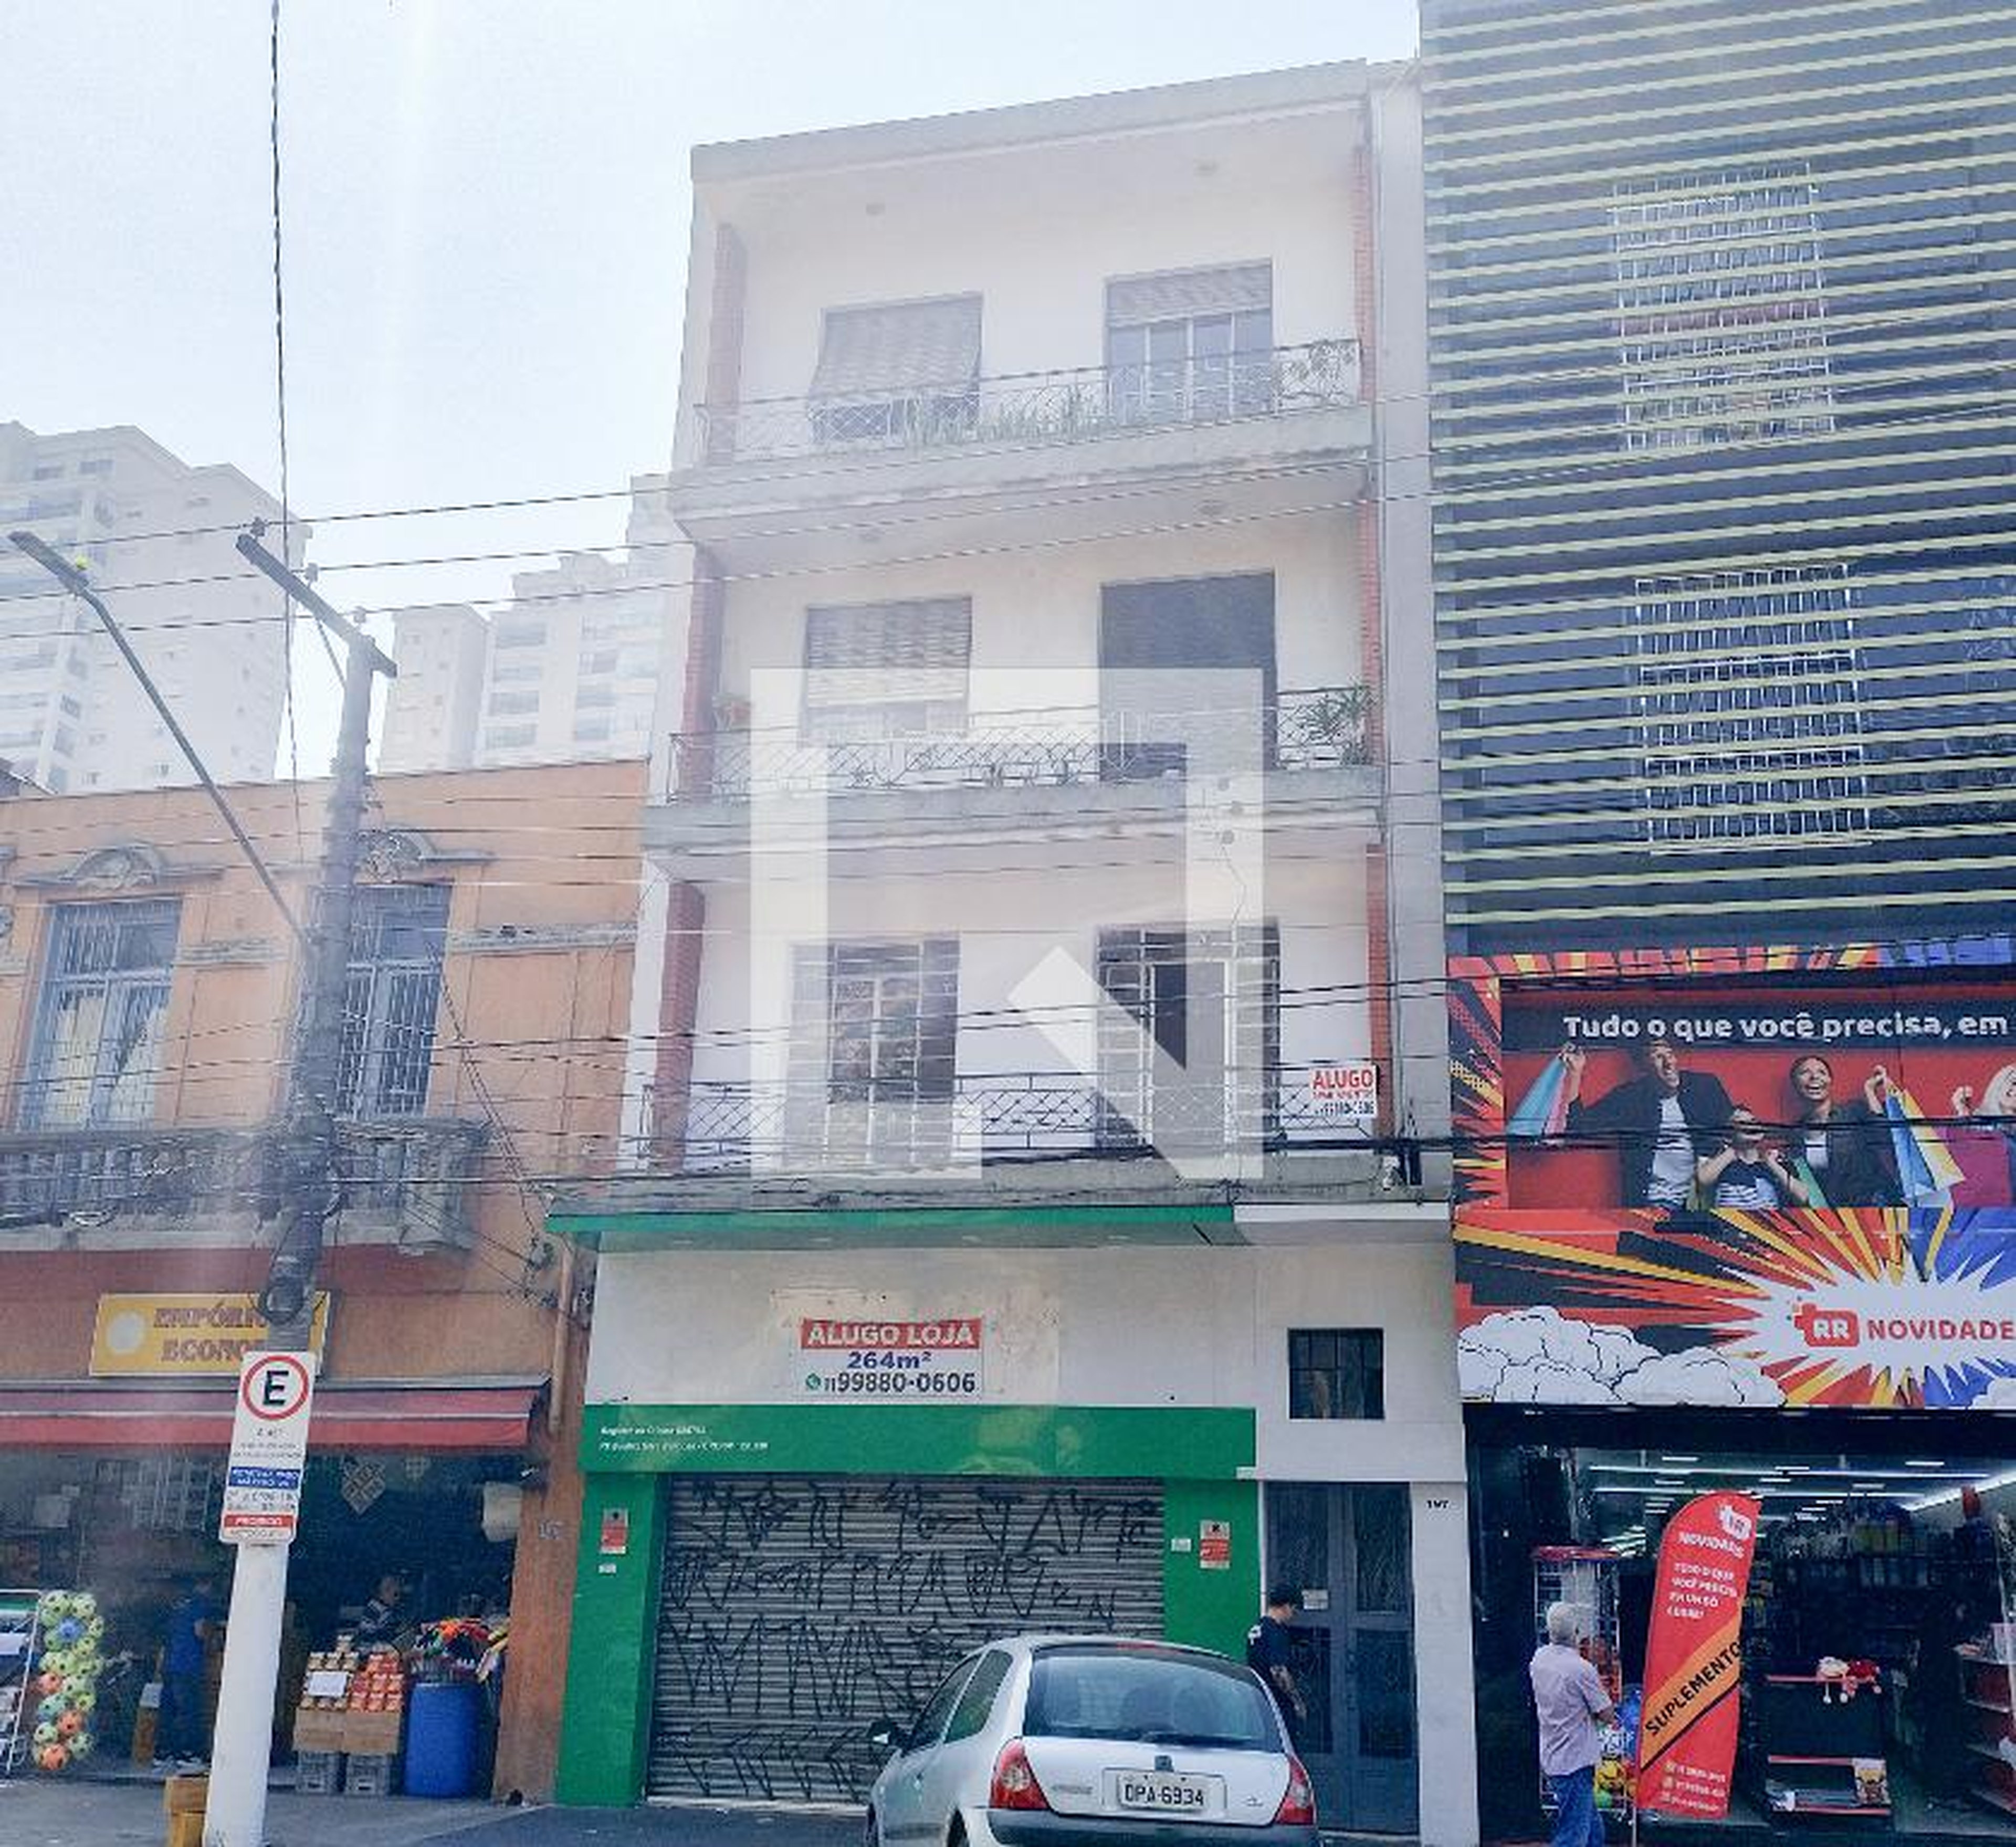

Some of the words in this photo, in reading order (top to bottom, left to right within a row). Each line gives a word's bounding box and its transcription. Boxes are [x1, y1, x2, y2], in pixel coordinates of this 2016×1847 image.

[1563, 1015, 1640, 1037] Tudo
[1647, 1018, 1666, 1037] o
[1674, 1018, 1733, 1042] que
[1738, 1012, 1814, 1037] você
[1823, 1011, 1951, 1042] precisa,
[1958, 1016, 2008, 1036] em
[1313, 1069, 1373, 1090] ALUGO
[808, 1324, 900, 1346] ALUGO
[908, 1324, 975, 1346] LOJA
[1813, 1318, 1849, 1338] RR
[1867, 1319, 2015, 1340] NOVIDADE
[847, 1351, 931, 1369] 264m²
[262, 1370, 289, 1406] E
